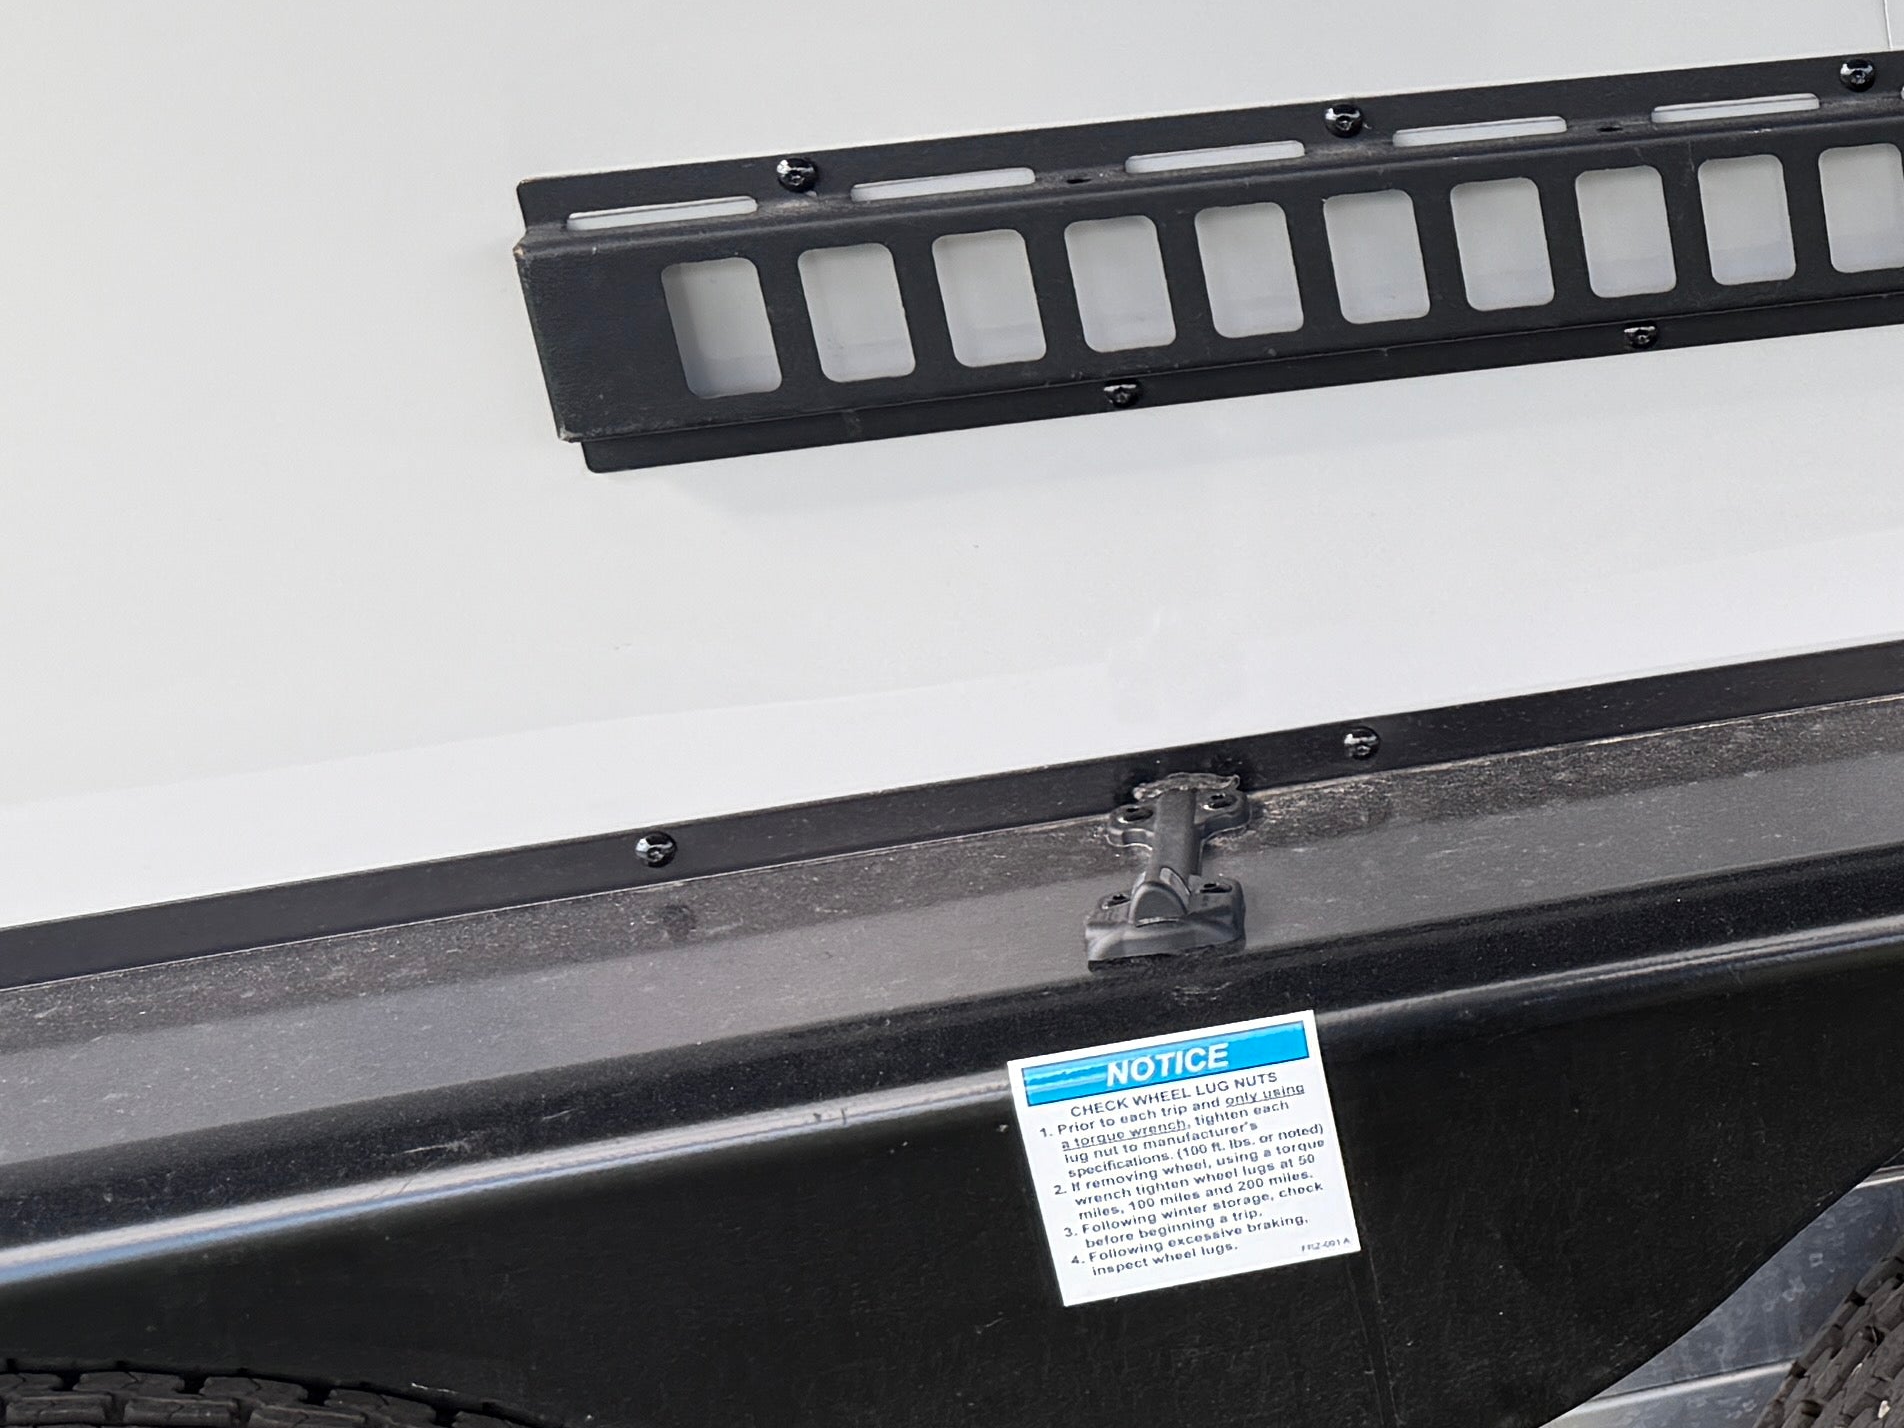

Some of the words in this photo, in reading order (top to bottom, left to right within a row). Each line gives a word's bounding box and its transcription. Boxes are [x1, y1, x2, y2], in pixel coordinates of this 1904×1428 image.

[1105, 1041, 1230, 1088] NOTICE
[1039, 1127, 1052, 1137] 1.
[1057, 1120, 1094, 1134] Prior
[1099, 1117, 1115, 1127] to
[1120, 1109, 1156, 1123] each
[1160, 1104, 1187, 1116] trip
[1192, 1096, 1219, 1111] and
[1225, 1091, 1258, 1108] only
[1262, 1084, 1304, 1101] using
[1070, 1097, 1128, 1117] CHECK
[1132, 1087, 1191, 1105] WHEEL
[1195, 1080, 1229, 1095] LUG
[1234, 1072, 1277, 1088] NUTS
[1061, 1141, 1071, 1151] a
[1073, 1131, 1126, 1149] torque
[1129, 1119, 1190, 1140] wrench,
[1194, 1109, 1248, 1125] tighten
[1253, 1100, 1288, 1114] each
[1064, 1152, 1088, 1163] lug
[1093, 1145, 1118, 1158] nut
[1122, 1144, 1137, 1153] to
[1143, 1121, 1257, 1149] manufacturer's
[1053, 1184, 1066, 1195] 2.
[1071, 1181, 1080, 1191] If
[1085, 1169, 1157, 1189] removing
[1161, 1158, 1211, 1174] wheel,
[1216, 1151, 1258, 1165] using
[1263, 1149, 1271, 1157] a
[1275, 1139, 1324, 1154] torque
[1068, 1152, 1173, 1178] specifications.
[1176, 1143, 1207, 1160] (100
[1210, 1142, 1225, 1152] ft.
[1228, 1138, 1255, 1149] lbs.
[1258, 1134, 1272, 1143] or
[1278, 1123, 1323, 1140] noted)
[1074, 1187, 1131, 1205] wrench
[1135, 1178, 1188, 1195] tighten
[1193, 1167, 1237, 1184] wheel
[1242, 1162, 1274, 1175] lugs
[1280, 1158, 1293, 1169] at
[1298, 1153, 1314, 1165] 50
[1078, 1206, 1124, 1220] miles,
[1128, 1197, 1154, 1210] 100
[1159, 1191, 1200, 1205] miles
[1205, 1182, 1233, 1197] and
[1237, 1177, 1263, 1191] 200
[1268, 1171, 1312, 1185] miles.
[1063, 1227, 1077, 1237] 3.
[1081, 1213, 1156, 1233] Following
[1161, 1204, 1206, 1219] winter
[1212, 1193, 1273, 1210] storage,
[1278, 1182, 1323, 1197] check
[1085, 1233, 1133, 1248] before
[1138, 1217, 1214, 1238] beginning
[1219, 1215, 1227, 1223] a
[1232, 1210, 1262, 1221] trip.
[1071, 1255, 1084, 1263] 4.
[1088, 1242, 1163, 1261] Following
[1167, 1227, 1241, 1247] excessive
[1246, 1216, 1307, 1232] braking,
[1092, 1257, 1147, 1275] inspect
[1152, 1248, 1196, 1264] wheel
[1200, 1243, 1237, 1255] lugs.
